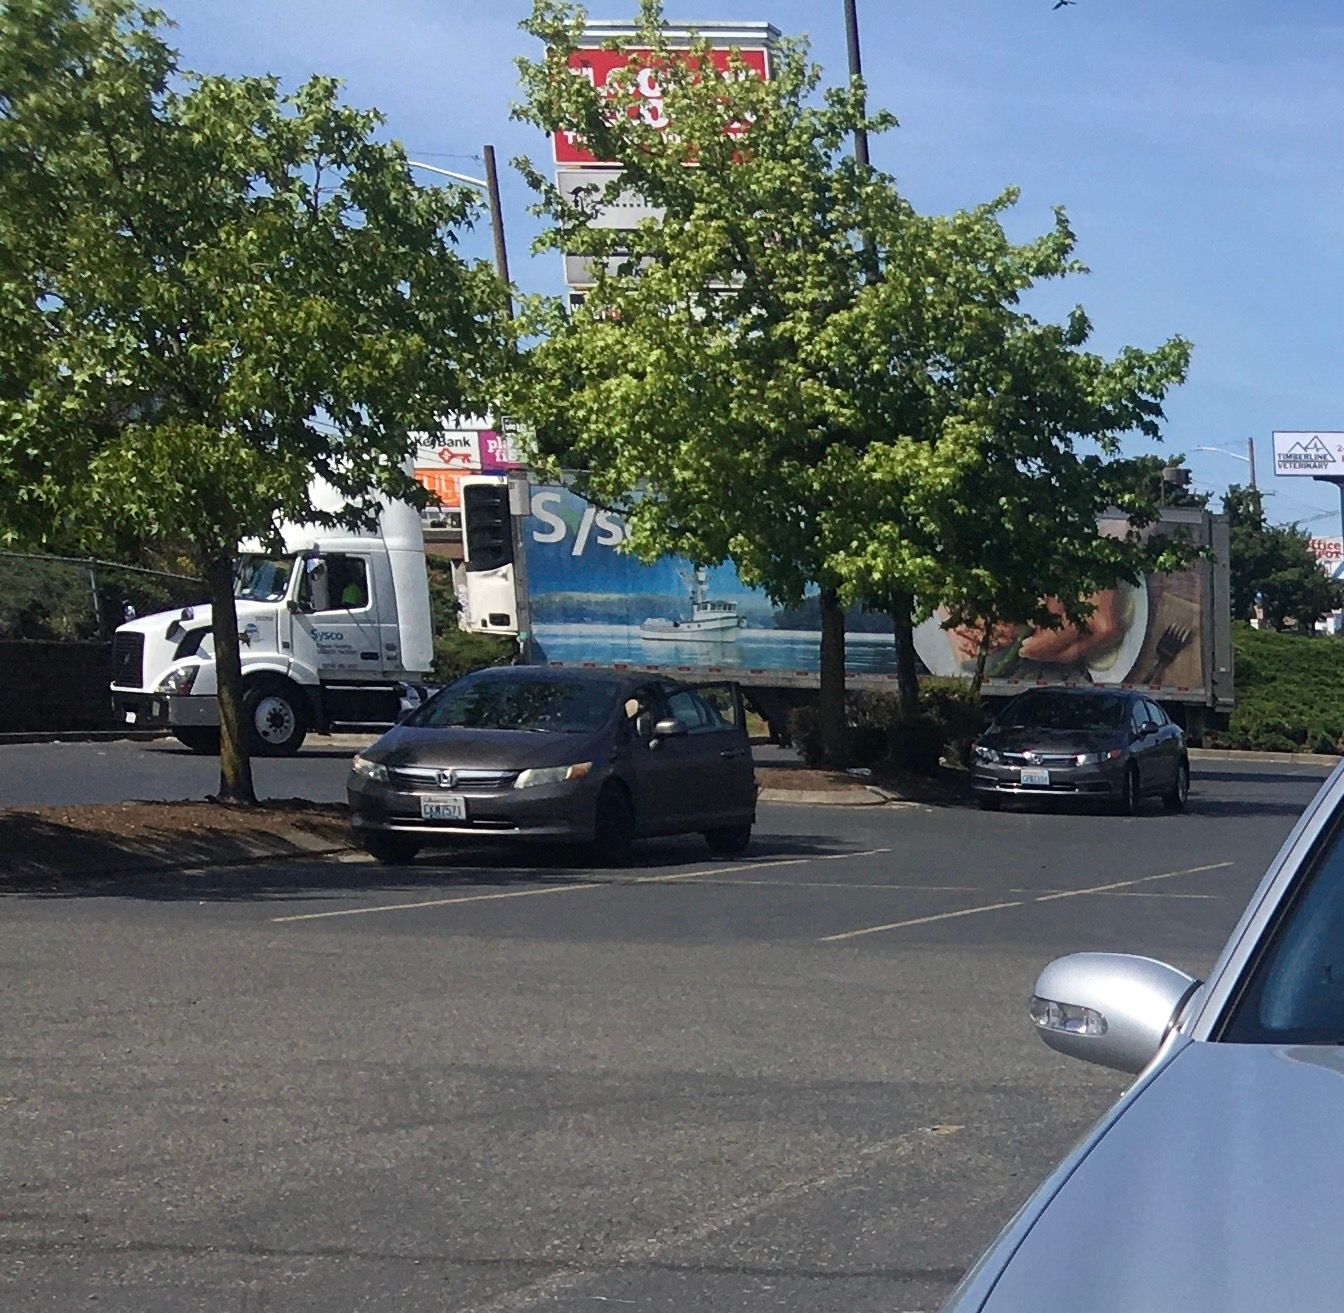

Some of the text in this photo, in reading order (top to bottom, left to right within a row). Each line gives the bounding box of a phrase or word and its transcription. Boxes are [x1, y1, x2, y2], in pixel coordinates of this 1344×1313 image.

[414, 436, 471, 449] KeyBank
[1277, 461, 1329, 470] VETERINARY
[311, 629, 344, 641] Sysco
